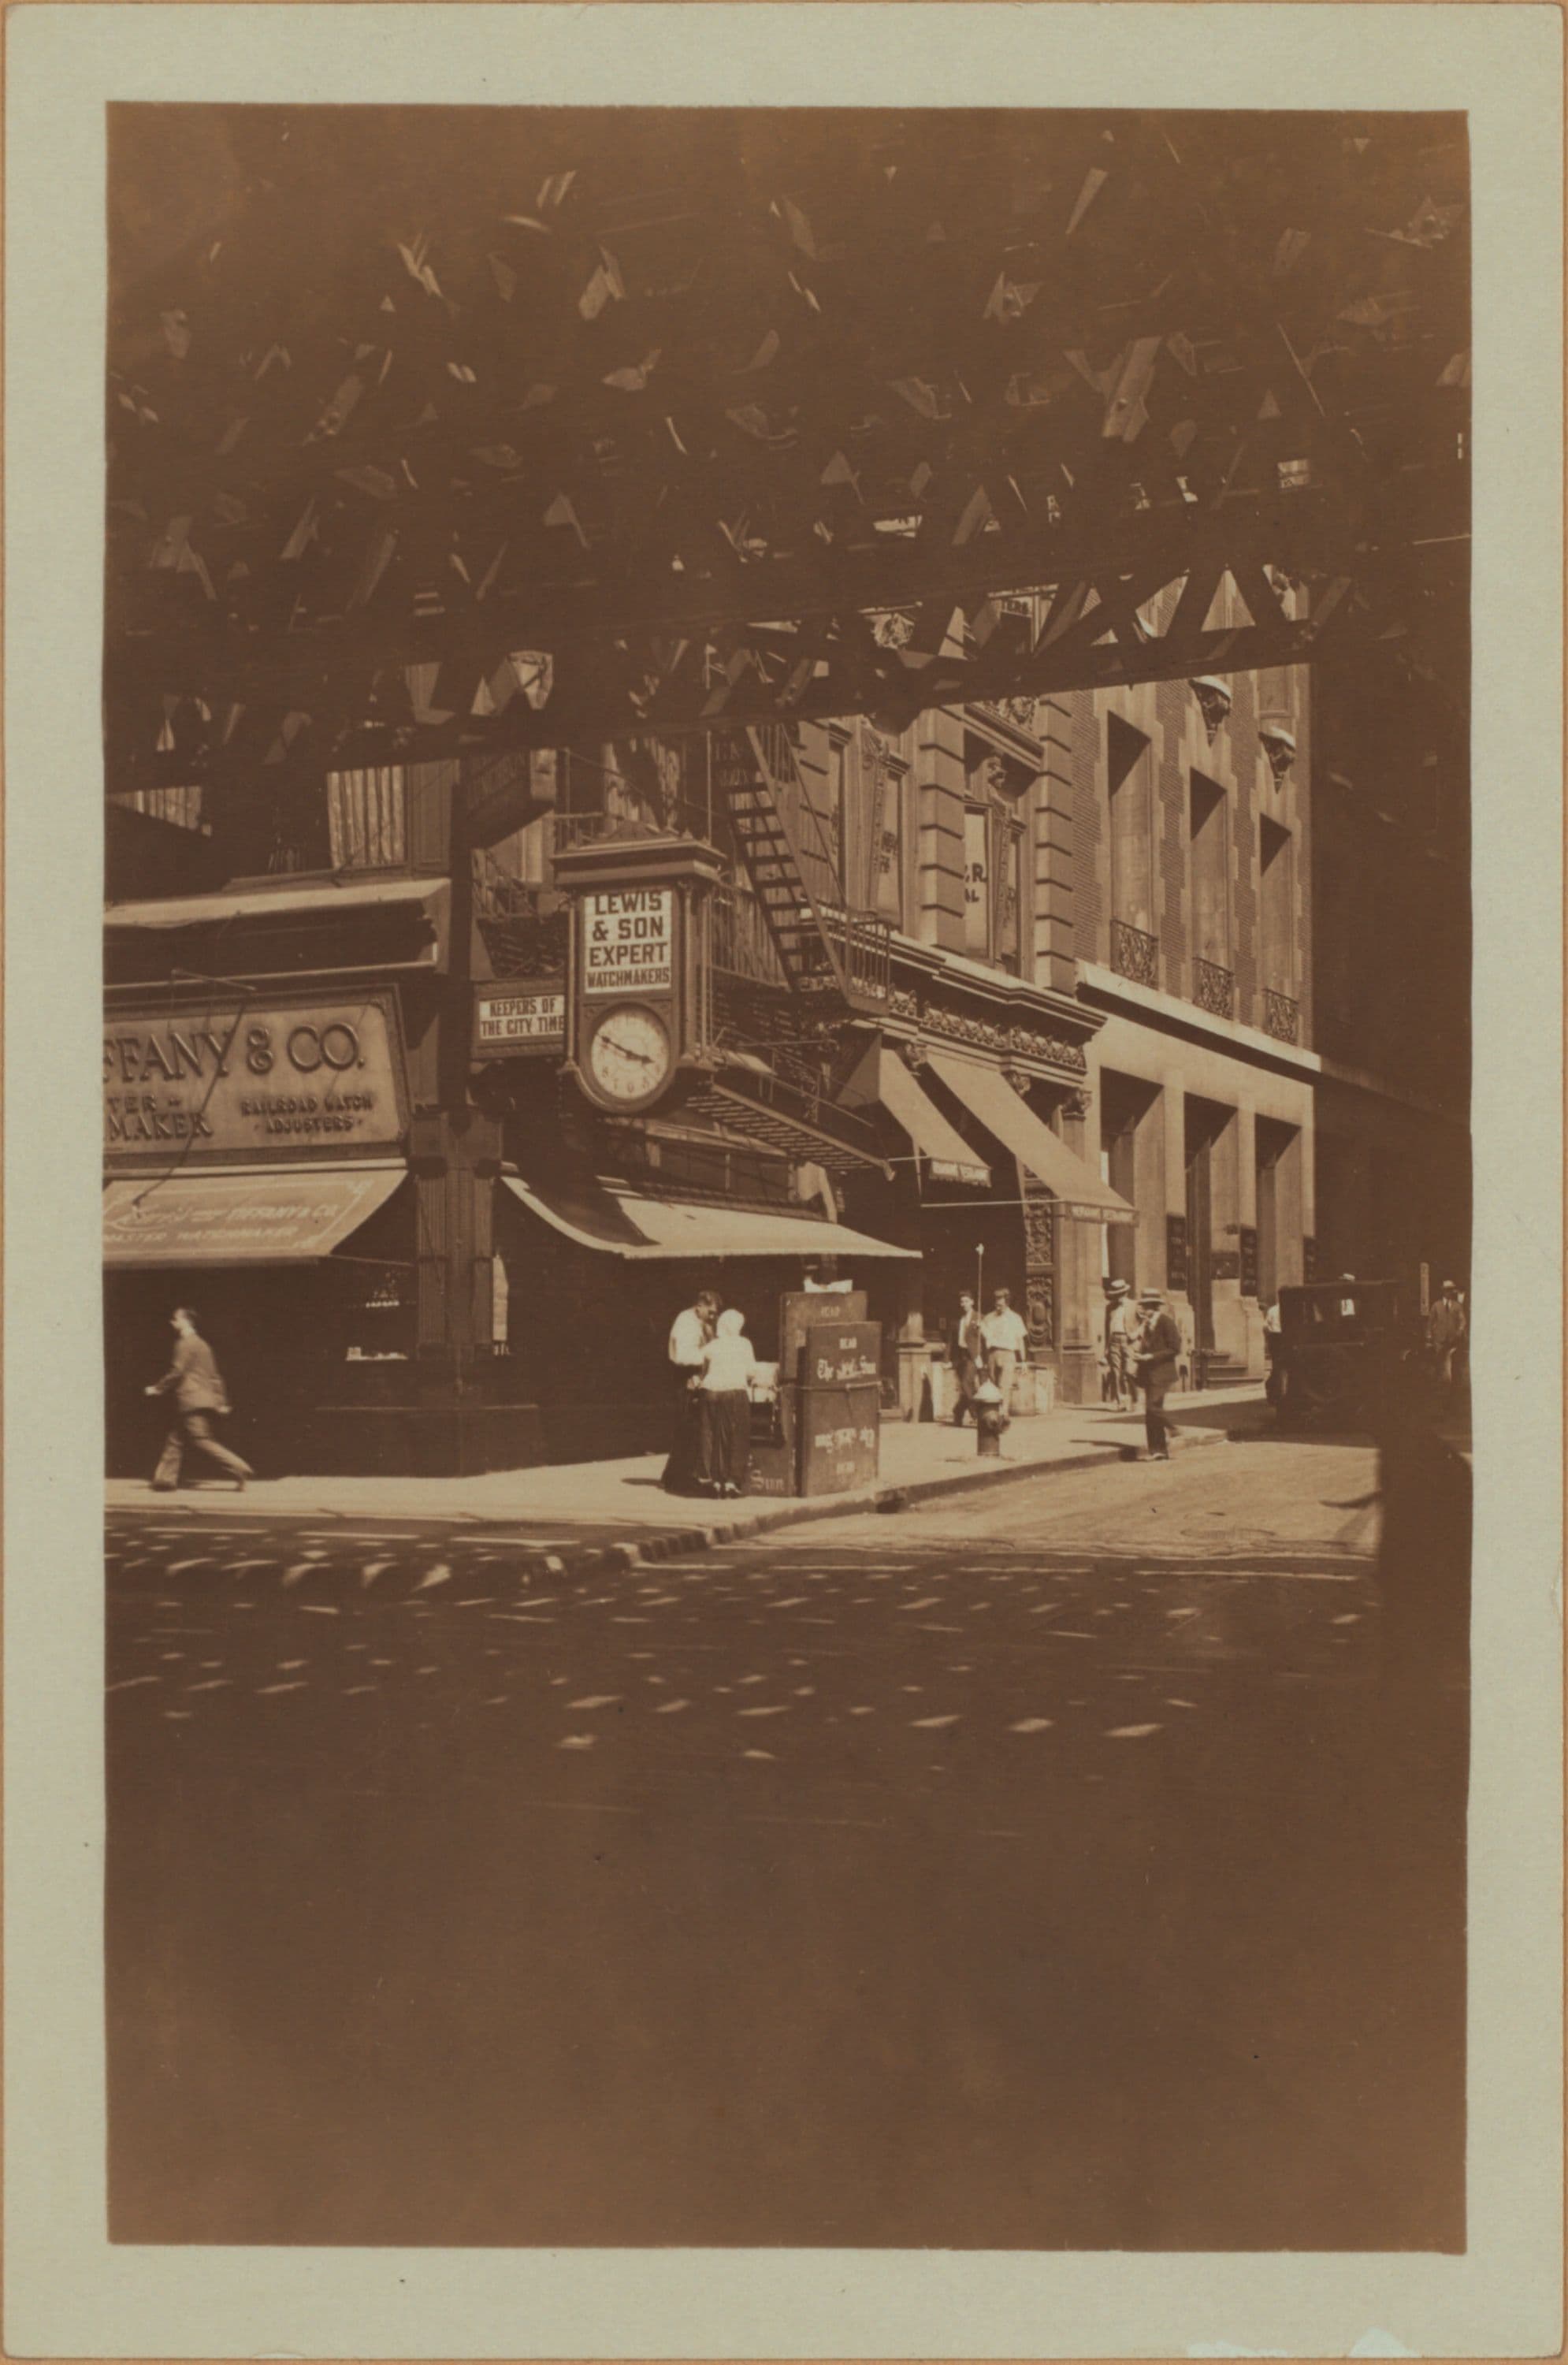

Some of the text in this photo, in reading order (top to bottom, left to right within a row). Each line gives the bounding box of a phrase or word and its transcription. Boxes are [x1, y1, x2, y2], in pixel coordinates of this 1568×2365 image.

[594, 891, 662, 915] LEWIS
[592, 916, 663, 942] & SON
[589, 942, 668, 967] EXPERT
[586, 967, 671, 988] WATCHMAKERS
[489, 996, 555, 1017] KEEPERS OF
[480, 1014, 565, 1038] THE CITY TIME
[247, 1027, 274, 1076] &
[286, 1022, 366, 1073] CO.
[324, 1094, 373, 1112] WATCH
[266, 1115, 354, 1135] ADJUSTERS
